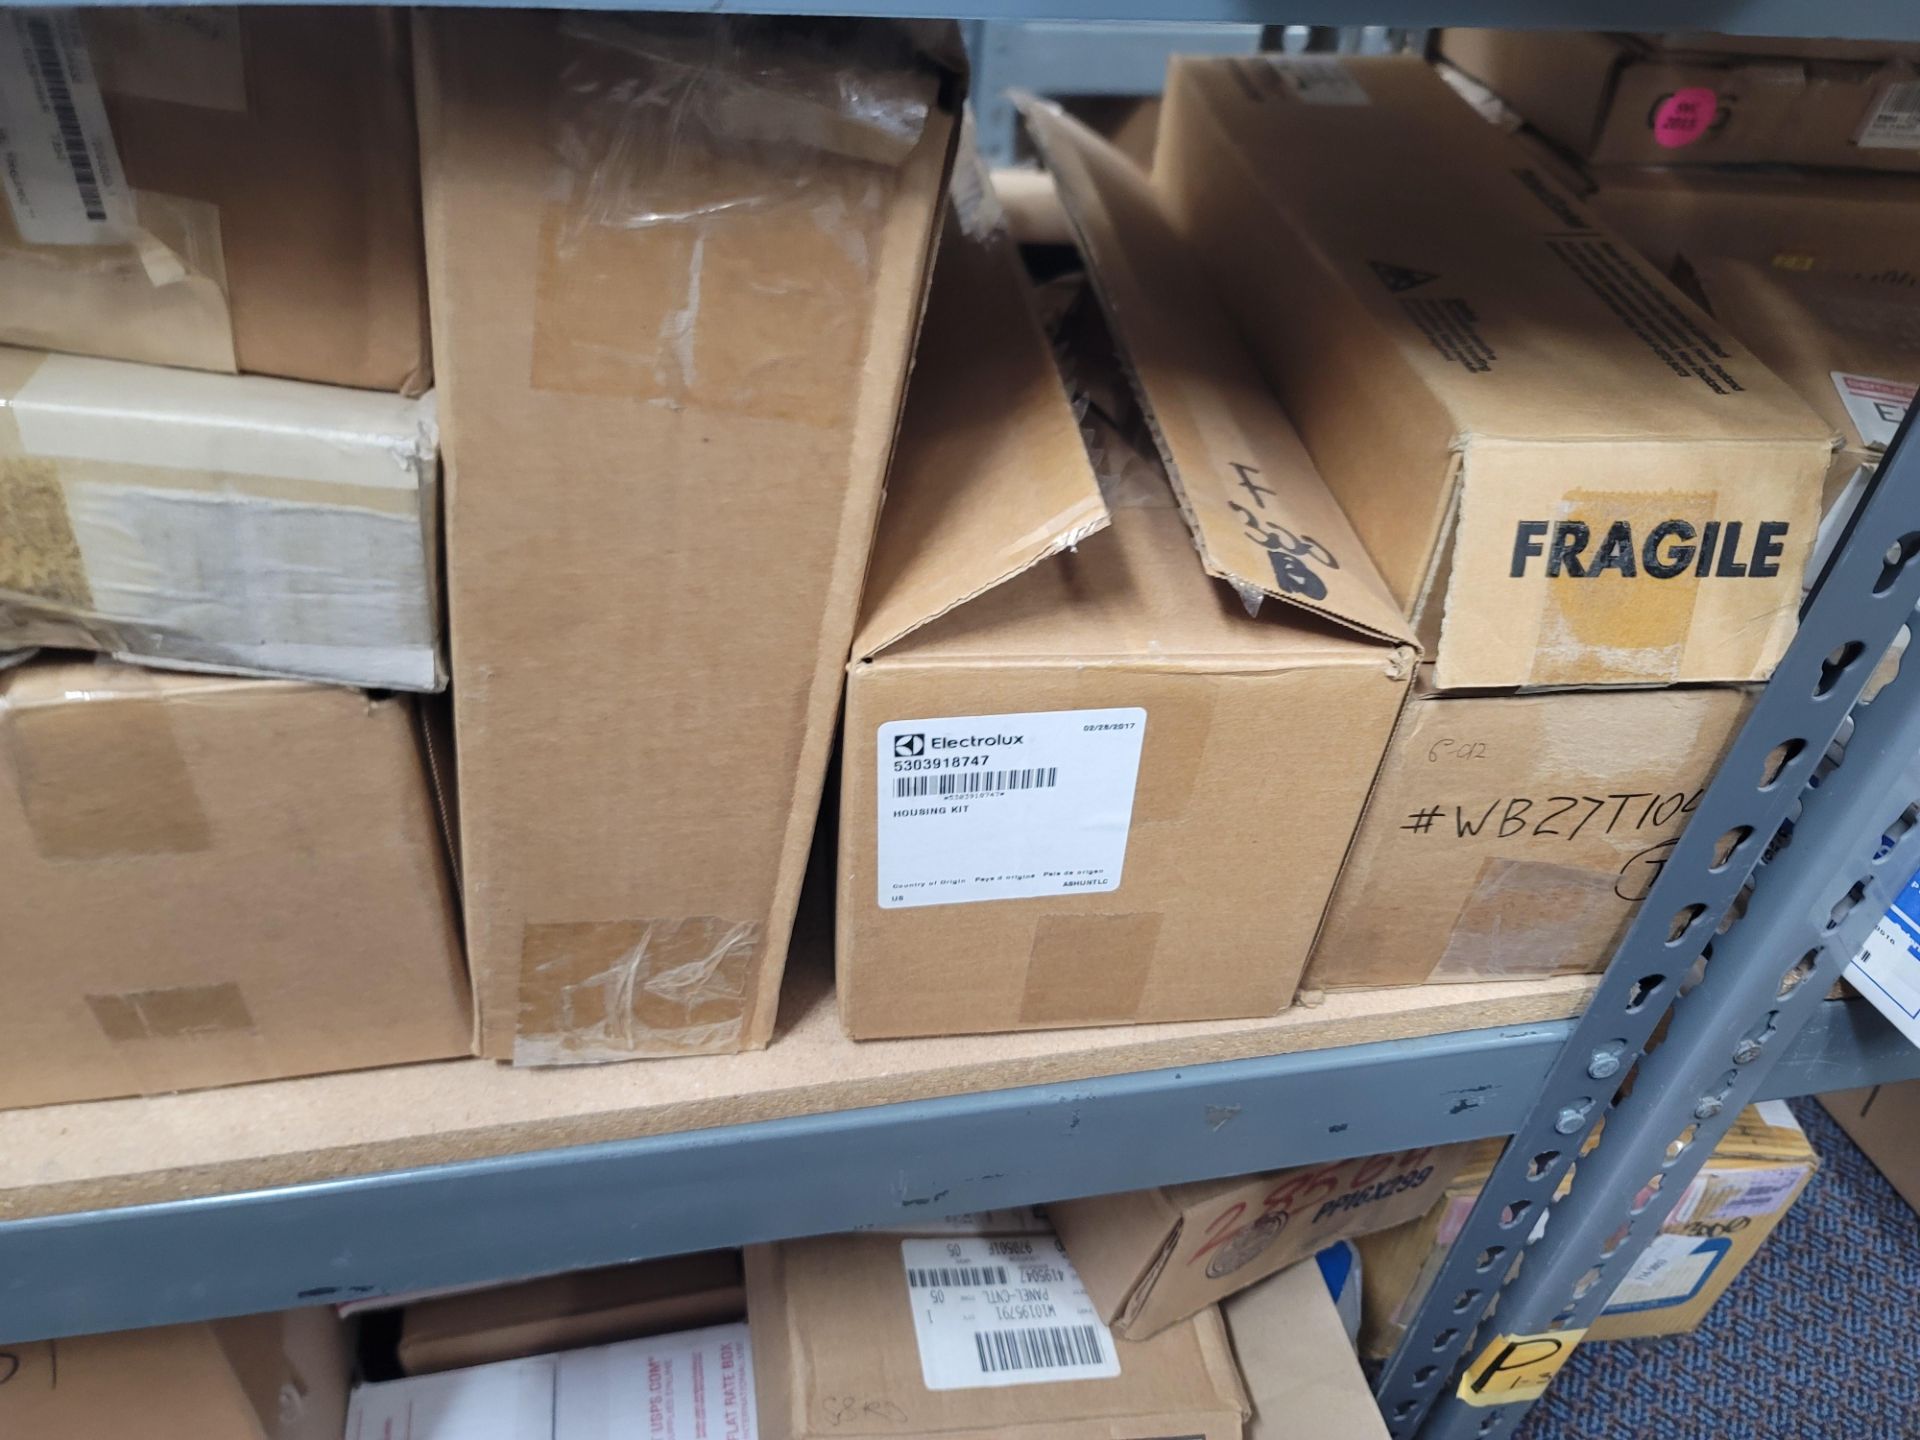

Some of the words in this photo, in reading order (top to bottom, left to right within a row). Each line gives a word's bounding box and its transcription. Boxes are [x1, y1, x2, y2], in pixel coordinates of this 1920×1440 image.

[1509, 518, 1790, 579] FRAGILE
[931, 734, 1024, 749] Electrolux
[894, 755, 990, 772] 5303918747
[893, 806, 947, 818] HOUSING
[951, 804, 970, 815] KIT
[892, 881, 926, 890] Country
[940, 878, 966, 887] Origin
[930, 1290, 945, 1304] 05
[995, 1304, 1057, 1321] W10195791
[720, 1342, 735, 1370] BOX
[1470, 1338, 1562, 1394] P
[722, 1371, 738, 1407] RATE
